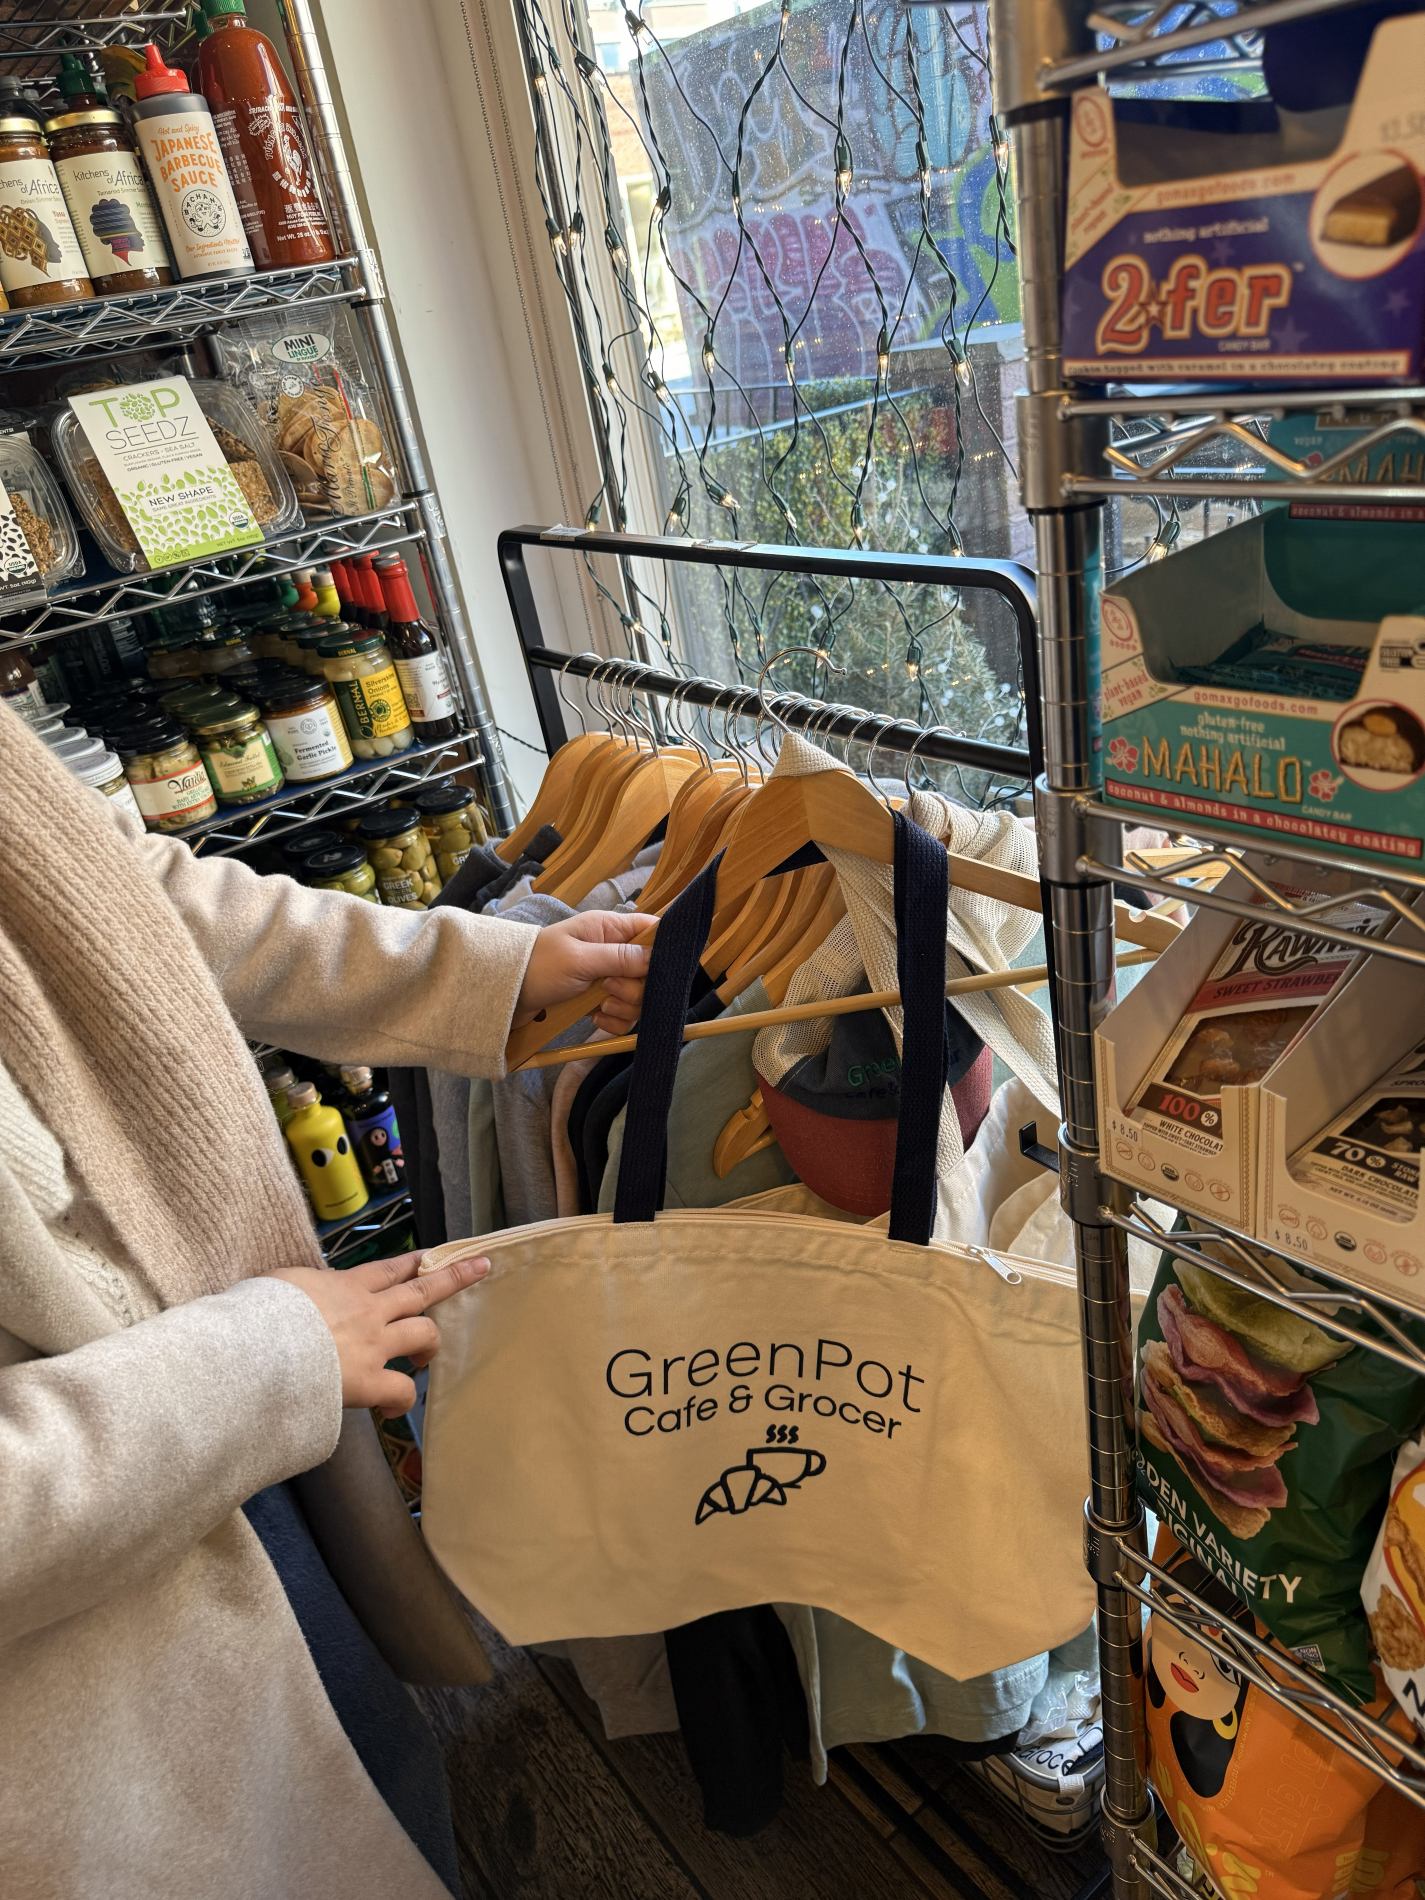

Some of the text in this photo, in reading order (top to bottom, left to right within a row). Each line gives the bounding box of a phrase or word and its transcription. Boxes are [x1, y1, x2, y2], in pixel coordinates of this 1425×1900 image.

[151, 132, 218, 161] JAPANESE
[73, 169, 110, 181] Kitchens
[106, 169, 145, 186] of Africa
[160, 153, 223, 182] BARBECUE
[20, 179, 60, 196] of Africa
[170, 170, 218, 192] SAUCE
[284, 334, 315, 351] MINI
[288, 345, 319, 358] LINGUE
[105, 416, 197, 450] SEEDZ
[123, 449, 160, 461] CRACKERS
[149, 486, 213, 506] NEW SHAPE
[1104, 670, 1149, 703] plant-based
[349, 681, 370, 724] BERNAL
[1118, 688, 1143, 706] vegan
[1193, 690, 1319, 716] gomaxgofoods.com
[1197, 711, 1265, 733] gluten-free
[294, 740, 329, 754] Fermented
[1181, 724, 1286, 752] nothing artificial
[297, 752, 318, 761] Garlic
[1141, 735, 1303, 803] MAHALO
[1108, 782, 1417, 857] coconut & almonds in a chocolatey coating
[383, 876, 414, 891] GREEK
[387, 891, 418, 905] OLIVES
[1214, 981, 1261, 999] SWEET
[1159, 1094, 1200, 1121] 100
[1112, 1120, 1117, 1131] $
[1120, 1124, 1138, 1143] 8.50
[1160, 1120, 1184, 1135] WHITE
[1330, 1141, 1366, 1161] 70
[1341, 1165, 1366, 1179] DARK
[1285, 1231, 1308, 1251] 8.50
[606, 1339, 925, 1413] GreenPot
[624, 1384, 902, 1439] Cafe & Grocer
[1192, 1511, 1302, 1604] VARIETY
